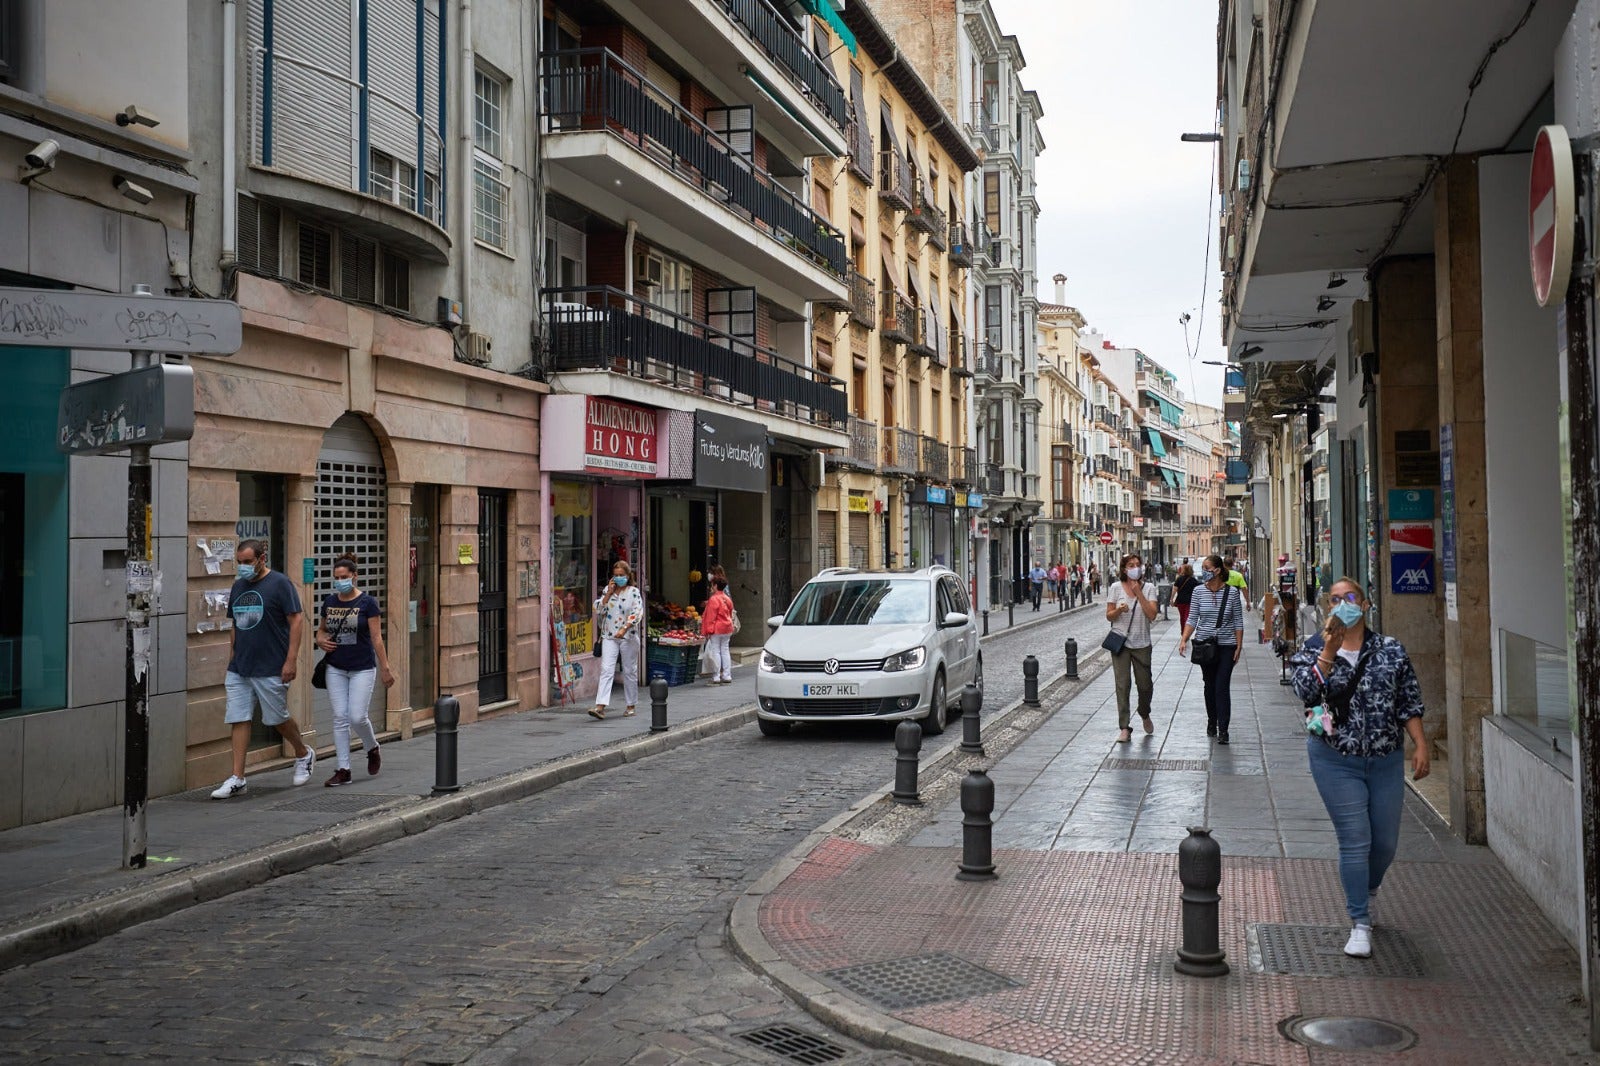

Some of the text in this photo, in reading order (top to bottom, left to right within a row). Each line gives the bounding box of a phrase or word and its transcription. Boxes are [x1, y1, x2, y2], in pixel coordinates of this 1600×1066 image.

[587, 400, 655, 436] ALIMENTACION
[593, 430, 649, 458] HONG
[700, 438, 765, 469] Frutas y Verduras Kilo
[236, 520, 269, 538] QUILA
[1395, 568, 1430, 585] AXA
[810, 686, 856, 696] 6287 HKL
